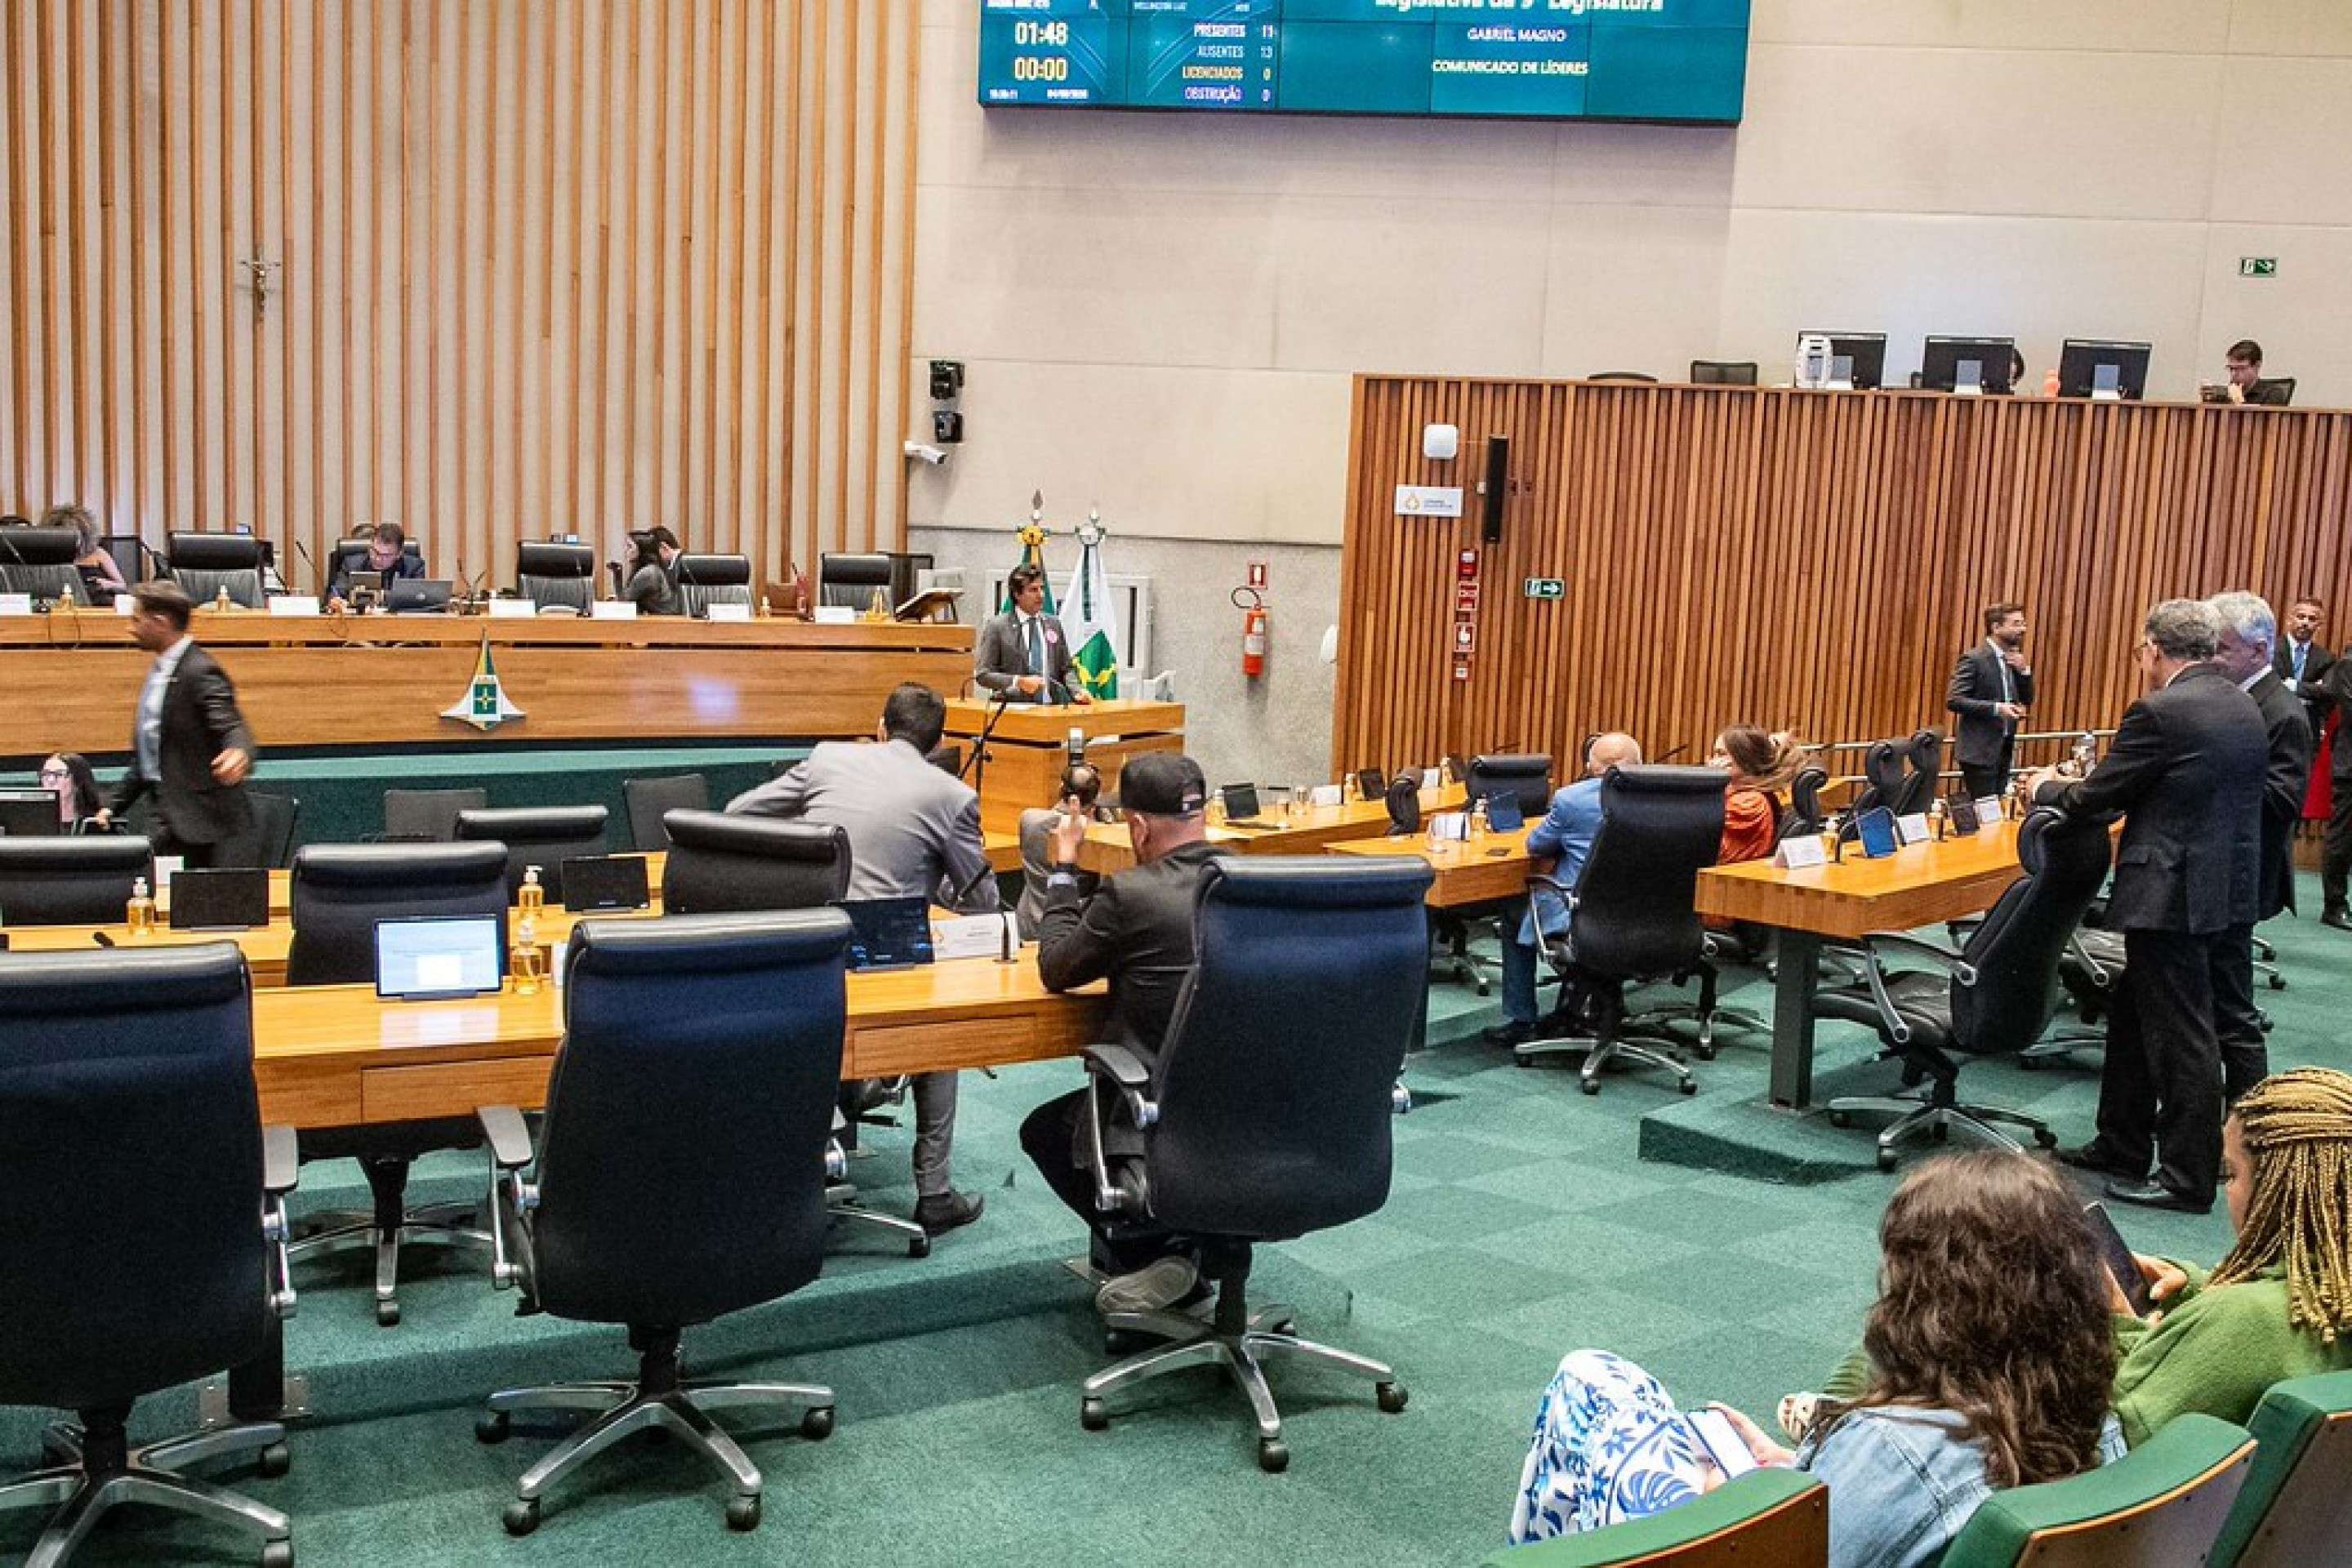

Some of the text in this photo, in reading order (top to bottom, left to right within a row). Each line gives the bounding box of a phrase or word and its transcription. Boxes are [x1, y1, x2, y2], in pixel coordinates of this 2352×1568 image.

[1014, 21, 1069, 47] 01:48
[1467, 27, 1567, 42] GABRIEL MAGNO
[1197, 45, 1243, 58] AUSENTES
[1014, 56, 1068, 81] 00:00
[1432, 60, 1518, 74] COMUNICADO
[1520, 61, 1538, 74] DE
